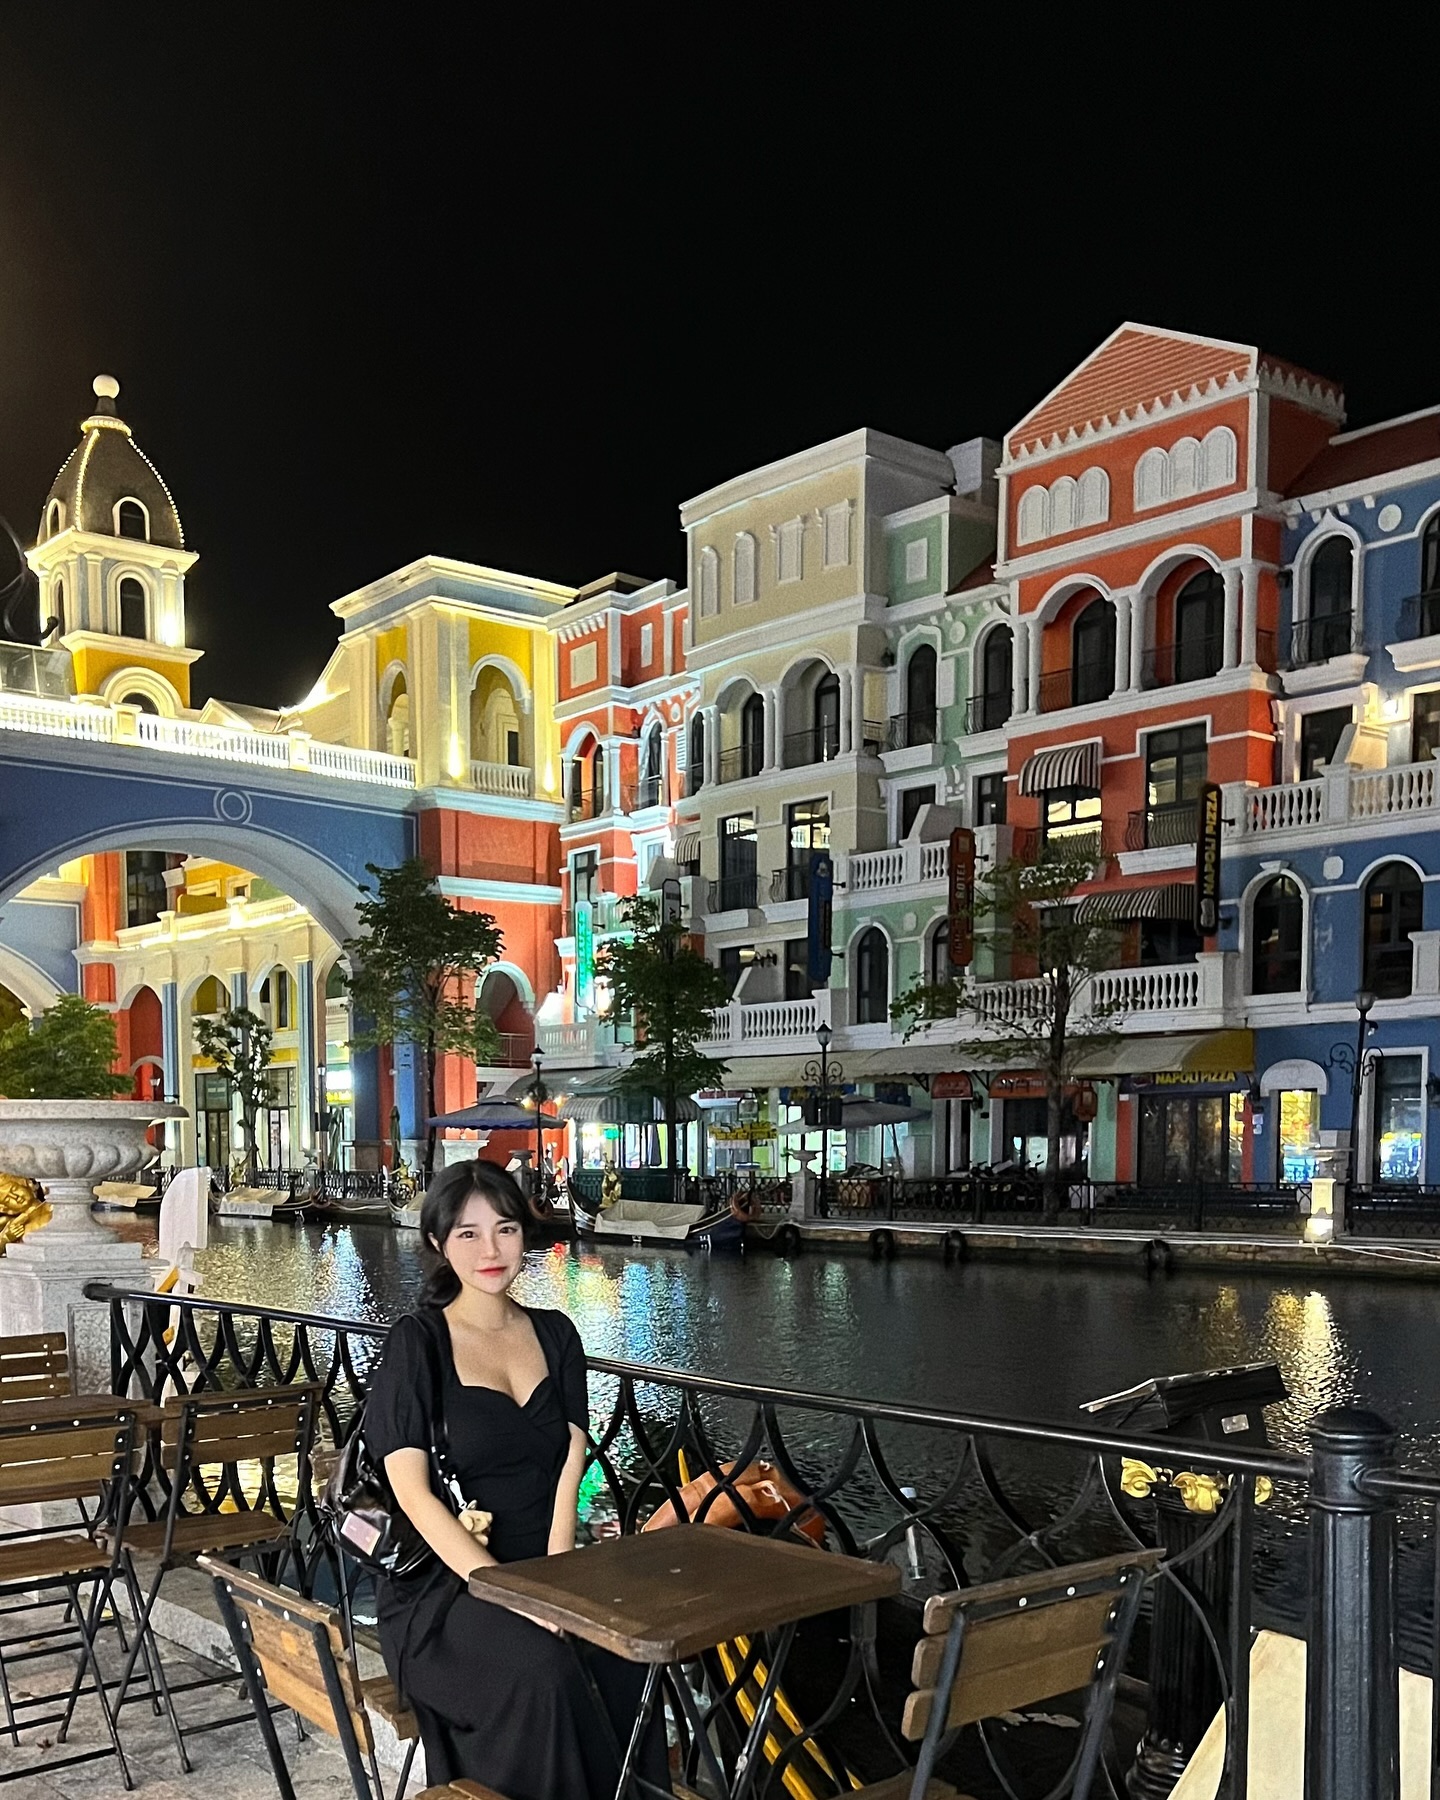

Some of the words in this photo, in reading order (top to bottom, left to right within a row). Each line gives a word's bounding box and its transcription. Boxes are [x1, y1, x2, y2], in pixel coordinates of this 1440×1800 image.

[1205, 790, 1217, 835] PIZZA
[1202, 837, 1216, 896] NAPOLI
[1155, 1072, 1199, 1085] NAPOLI
[1200, 1070, 1236, 1083] PIZZA
